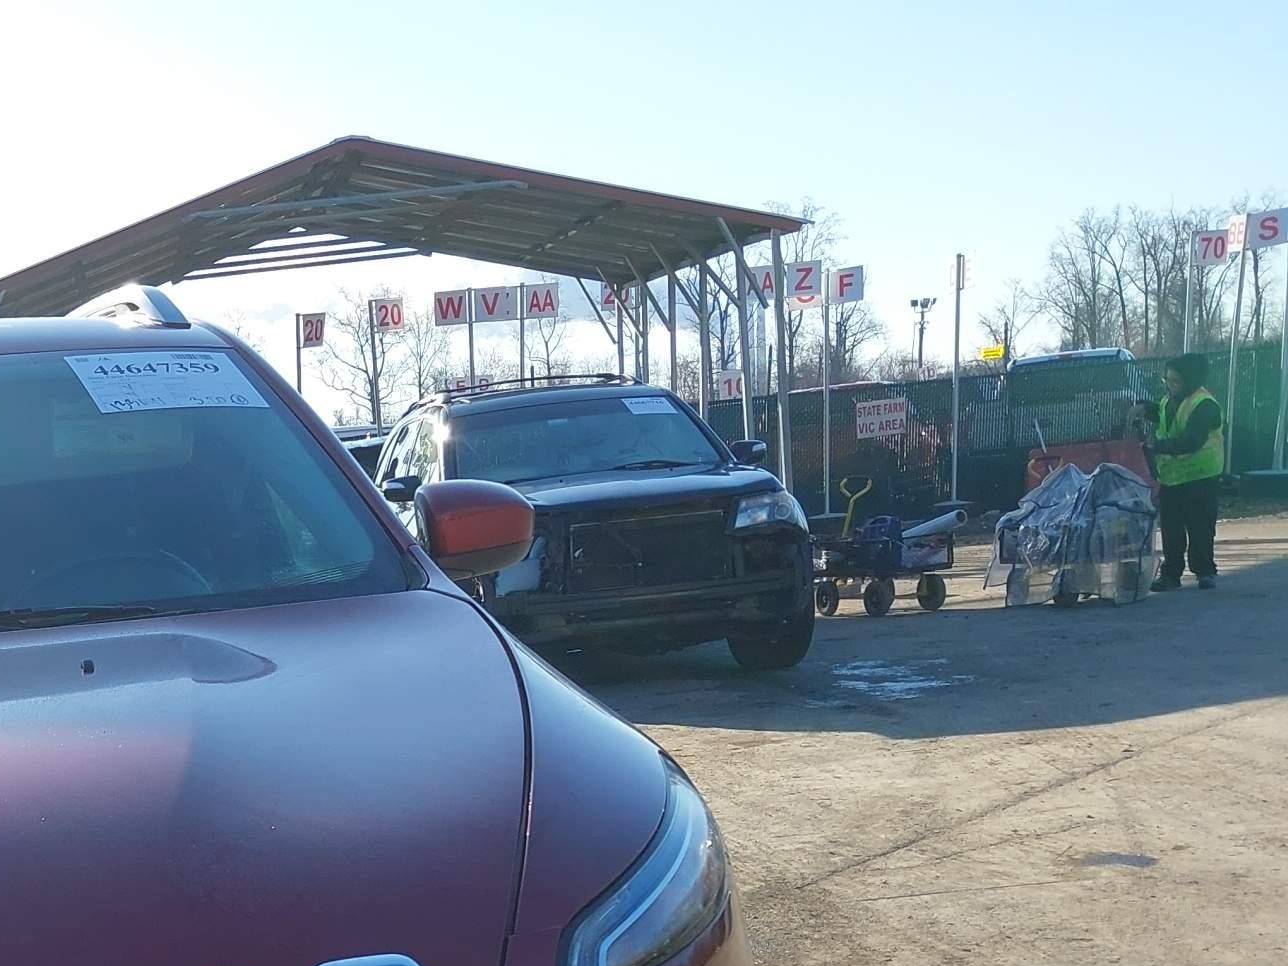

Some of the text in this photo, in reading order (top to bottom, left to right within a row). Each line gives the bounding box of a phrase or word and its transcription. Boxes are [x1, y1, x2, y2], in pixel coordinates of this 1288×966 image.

[1258, 216, 1279, 241] S
[1201, 236, 1225, 260] 70
[794, 267, 814, 291] Z
[839, 273, 855, 298] F
[437, 296, 463, 320] W
[528, 288, 555, 313] AA
[378, 303, 402, 327] 20
[304, 318, 323, 342] 20
[94, 362, 220, 377] 44647359
[857, 401, 905, 418] STATE FARM
[858, 418, 905, 434] VIC AREA
